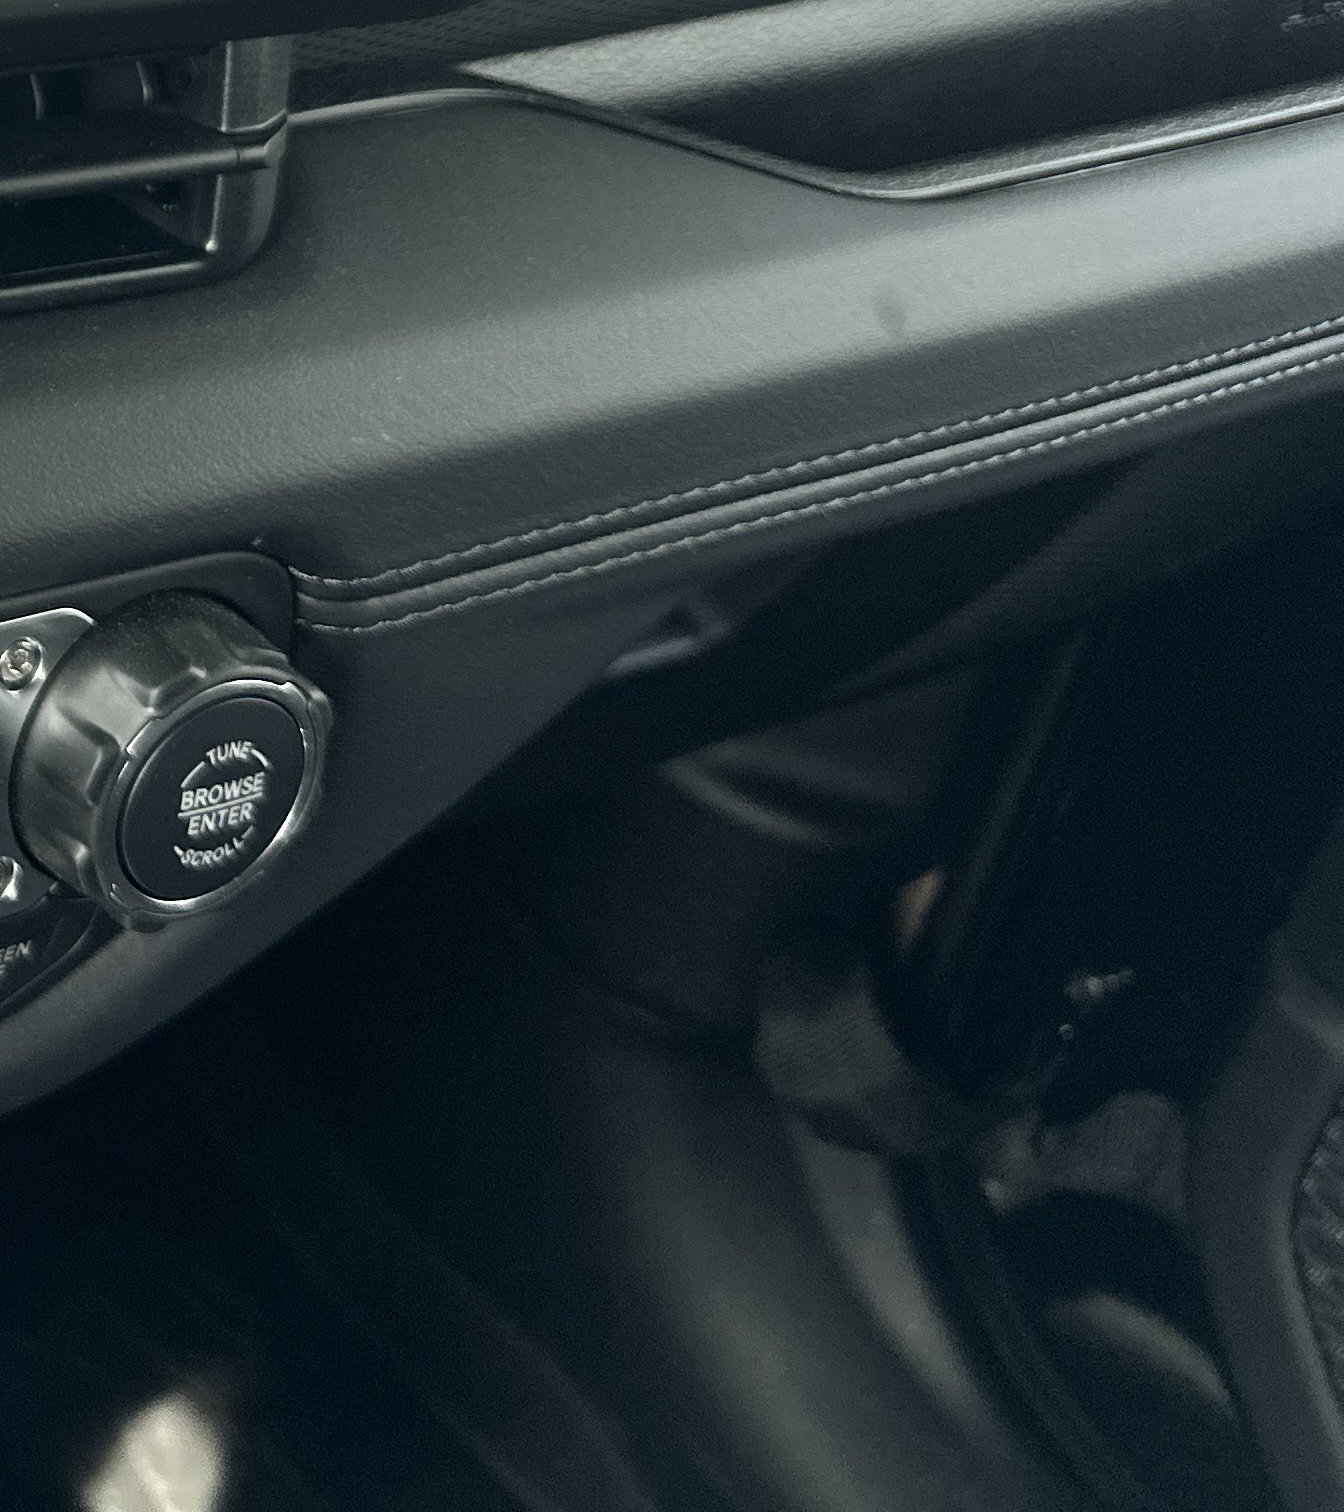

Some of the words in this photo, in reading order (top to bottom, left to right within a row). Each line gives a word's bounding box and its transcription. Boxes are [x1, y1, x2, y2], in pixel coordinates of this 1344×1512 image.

[205, 739, 253, 766] TUNE
[179, 771, 266, 812] BROWSE
[187, 801, 254, 837] ENTER
[179, 836, 245, 868] SCROLL
